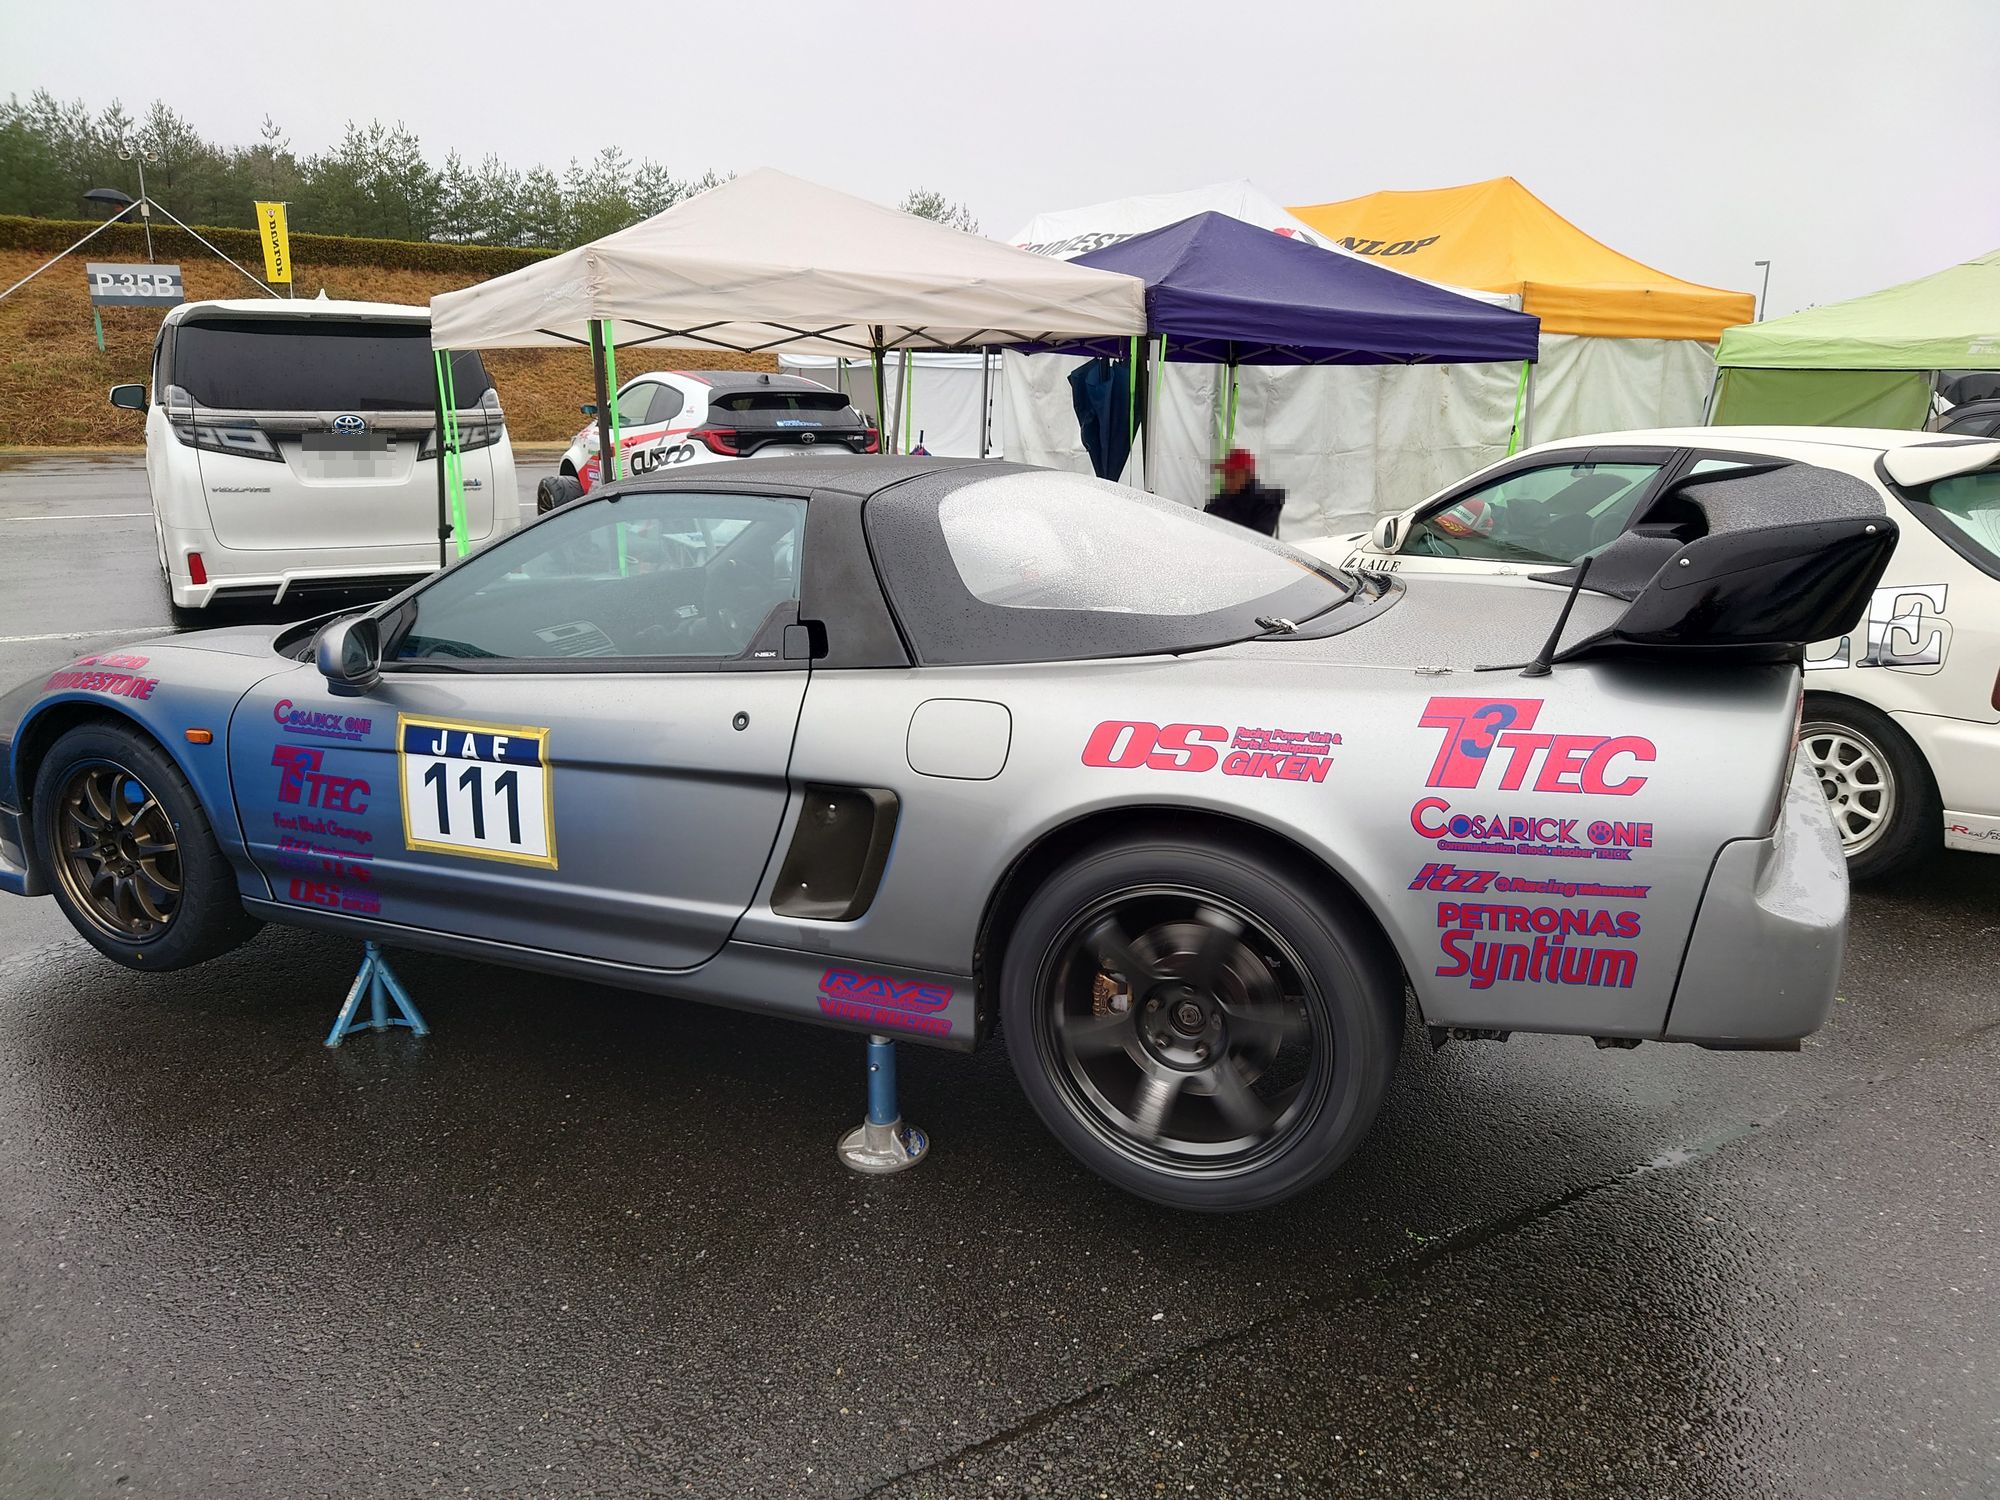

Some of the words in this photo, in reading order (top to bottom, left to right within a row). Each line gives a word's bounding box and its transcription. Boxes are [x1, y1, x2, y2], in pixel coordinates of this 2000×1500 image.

[1336, 235, 1440, 256] NLOP
[96, 273, 175, 297] P-35B
[631, 444, 697, 476] CUSCO
[1358, 557, 1401, 573] LAILE
[344, 717, 372, 735] ONE
[1235, 727, 1272, 741] Racing
[1272, 729, 1308, 743] Power
[1308, 732, 1332, 744] Unit
[1081, 720, 1229, 773] OS
[1260, 740, 1331, 758] Development
[1221, 751, 1335, 783] GIKEN
[424, 762, 522, 845] 111
[1587, 820, 1654, 848] ONE
[1516, 843, 1550, 856] Shock
[1594, 847, 1632, 860] TRICK
[1437, 902, 1642, 939] PETRONAS
[1435, 930, 1639, 990] Syntium
[821, 971, 951, 1008] RAYS
